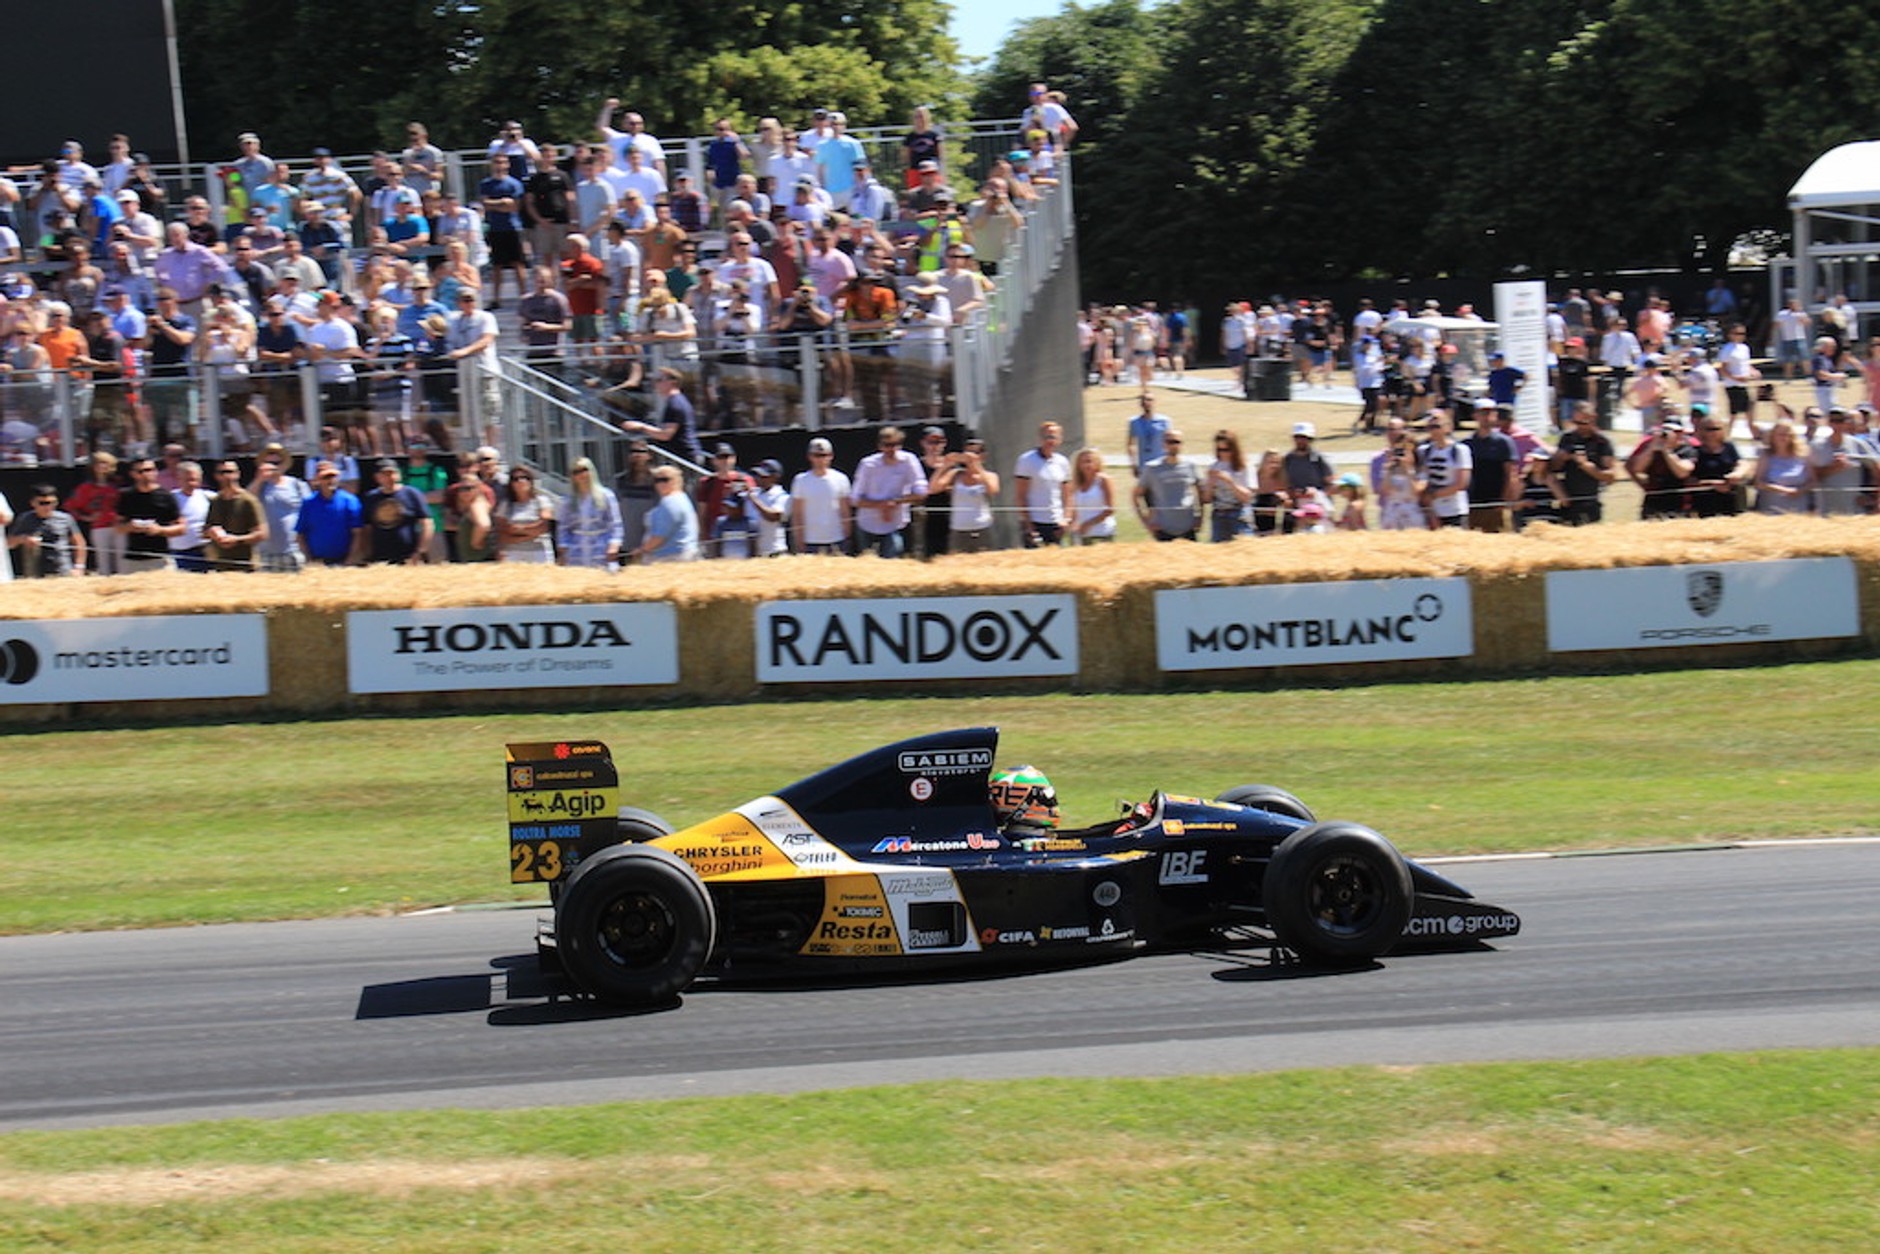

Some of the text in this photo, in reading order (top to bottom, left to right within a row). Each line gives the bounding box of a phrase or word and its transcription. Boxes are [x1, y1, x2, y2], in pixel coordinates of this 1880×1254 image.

[394, 620, 632, 654] HONDA
[770, 608, 1062, 667] RANDOX
[1188, 613, 1415, 654] MONTBLANC
[1640, 624, 1772, 642] PORSCHE
[54, 642, 231, 669] mastercard
[413, 655, 612, 676] The Power of Dreams
[903, 753, 988, 767] SABIEM
[549, 792, 606, 816] Agip
[673, 845, 763, 858] CHRYSLER
[871, 836, 967, 852] Mercatone
[511, 842, 561, 881] 23
[1159, 850, 1207, 880] IBF
[820, 921, 892, 939] Resta
[1465, 914, 1518, 934] group
[999, 931, 1034, 943] CIFA
